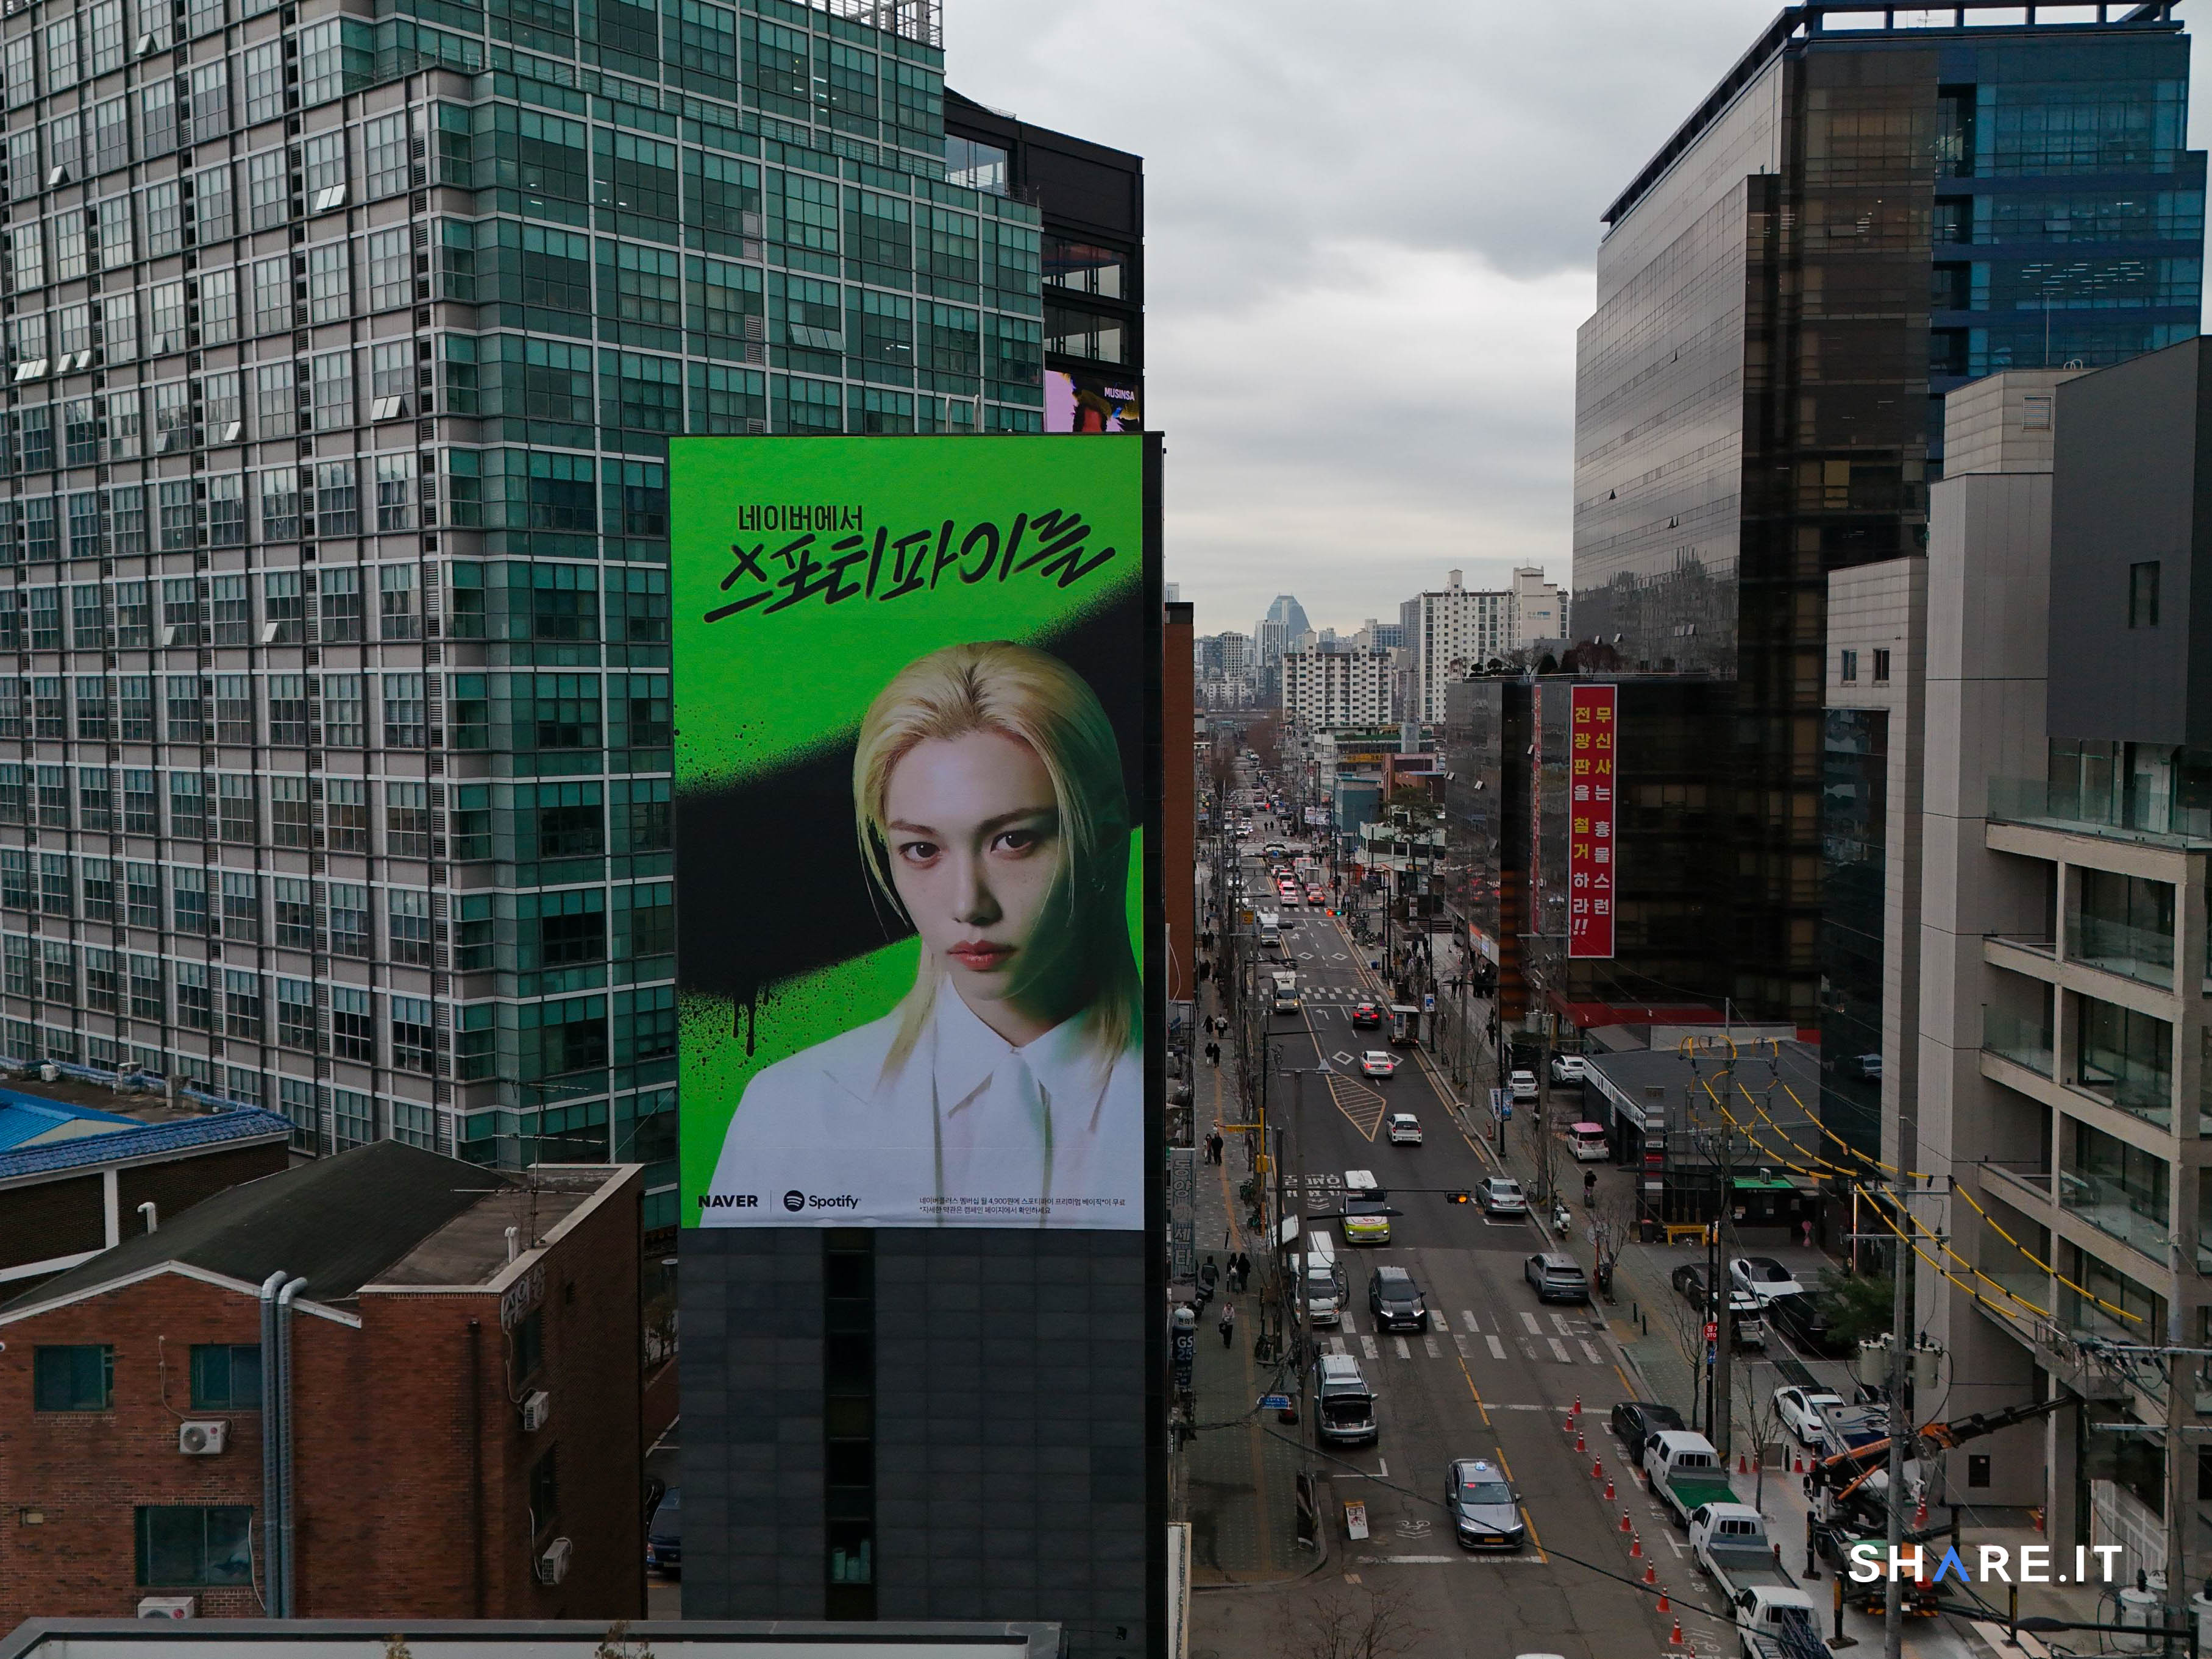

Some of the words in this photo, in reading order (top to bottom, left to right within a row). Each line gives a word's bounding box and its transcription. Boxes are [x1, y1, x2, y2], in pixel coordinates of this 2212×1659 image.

[1104, 387, 1135, 401] MUSINSA
[738, 505, 862, 532] 네이버에서
[703, 508, 1116, 623] 스포티파이를
[1574, 708, 1590, 801] 전광판을
[1595, 708, 1611, 801] 무신사는
[1573, 818, 1590, 936] 철거하라!!
[1594, 822, 1610, 915] 흉물스런
[698, 1195, 758, 1207] NAVER
[809, 1195, 859, 1209] Spotify
[1177, 1335, 1193, 1348] GS
[1178, 1348, 1192, 1360] 25
